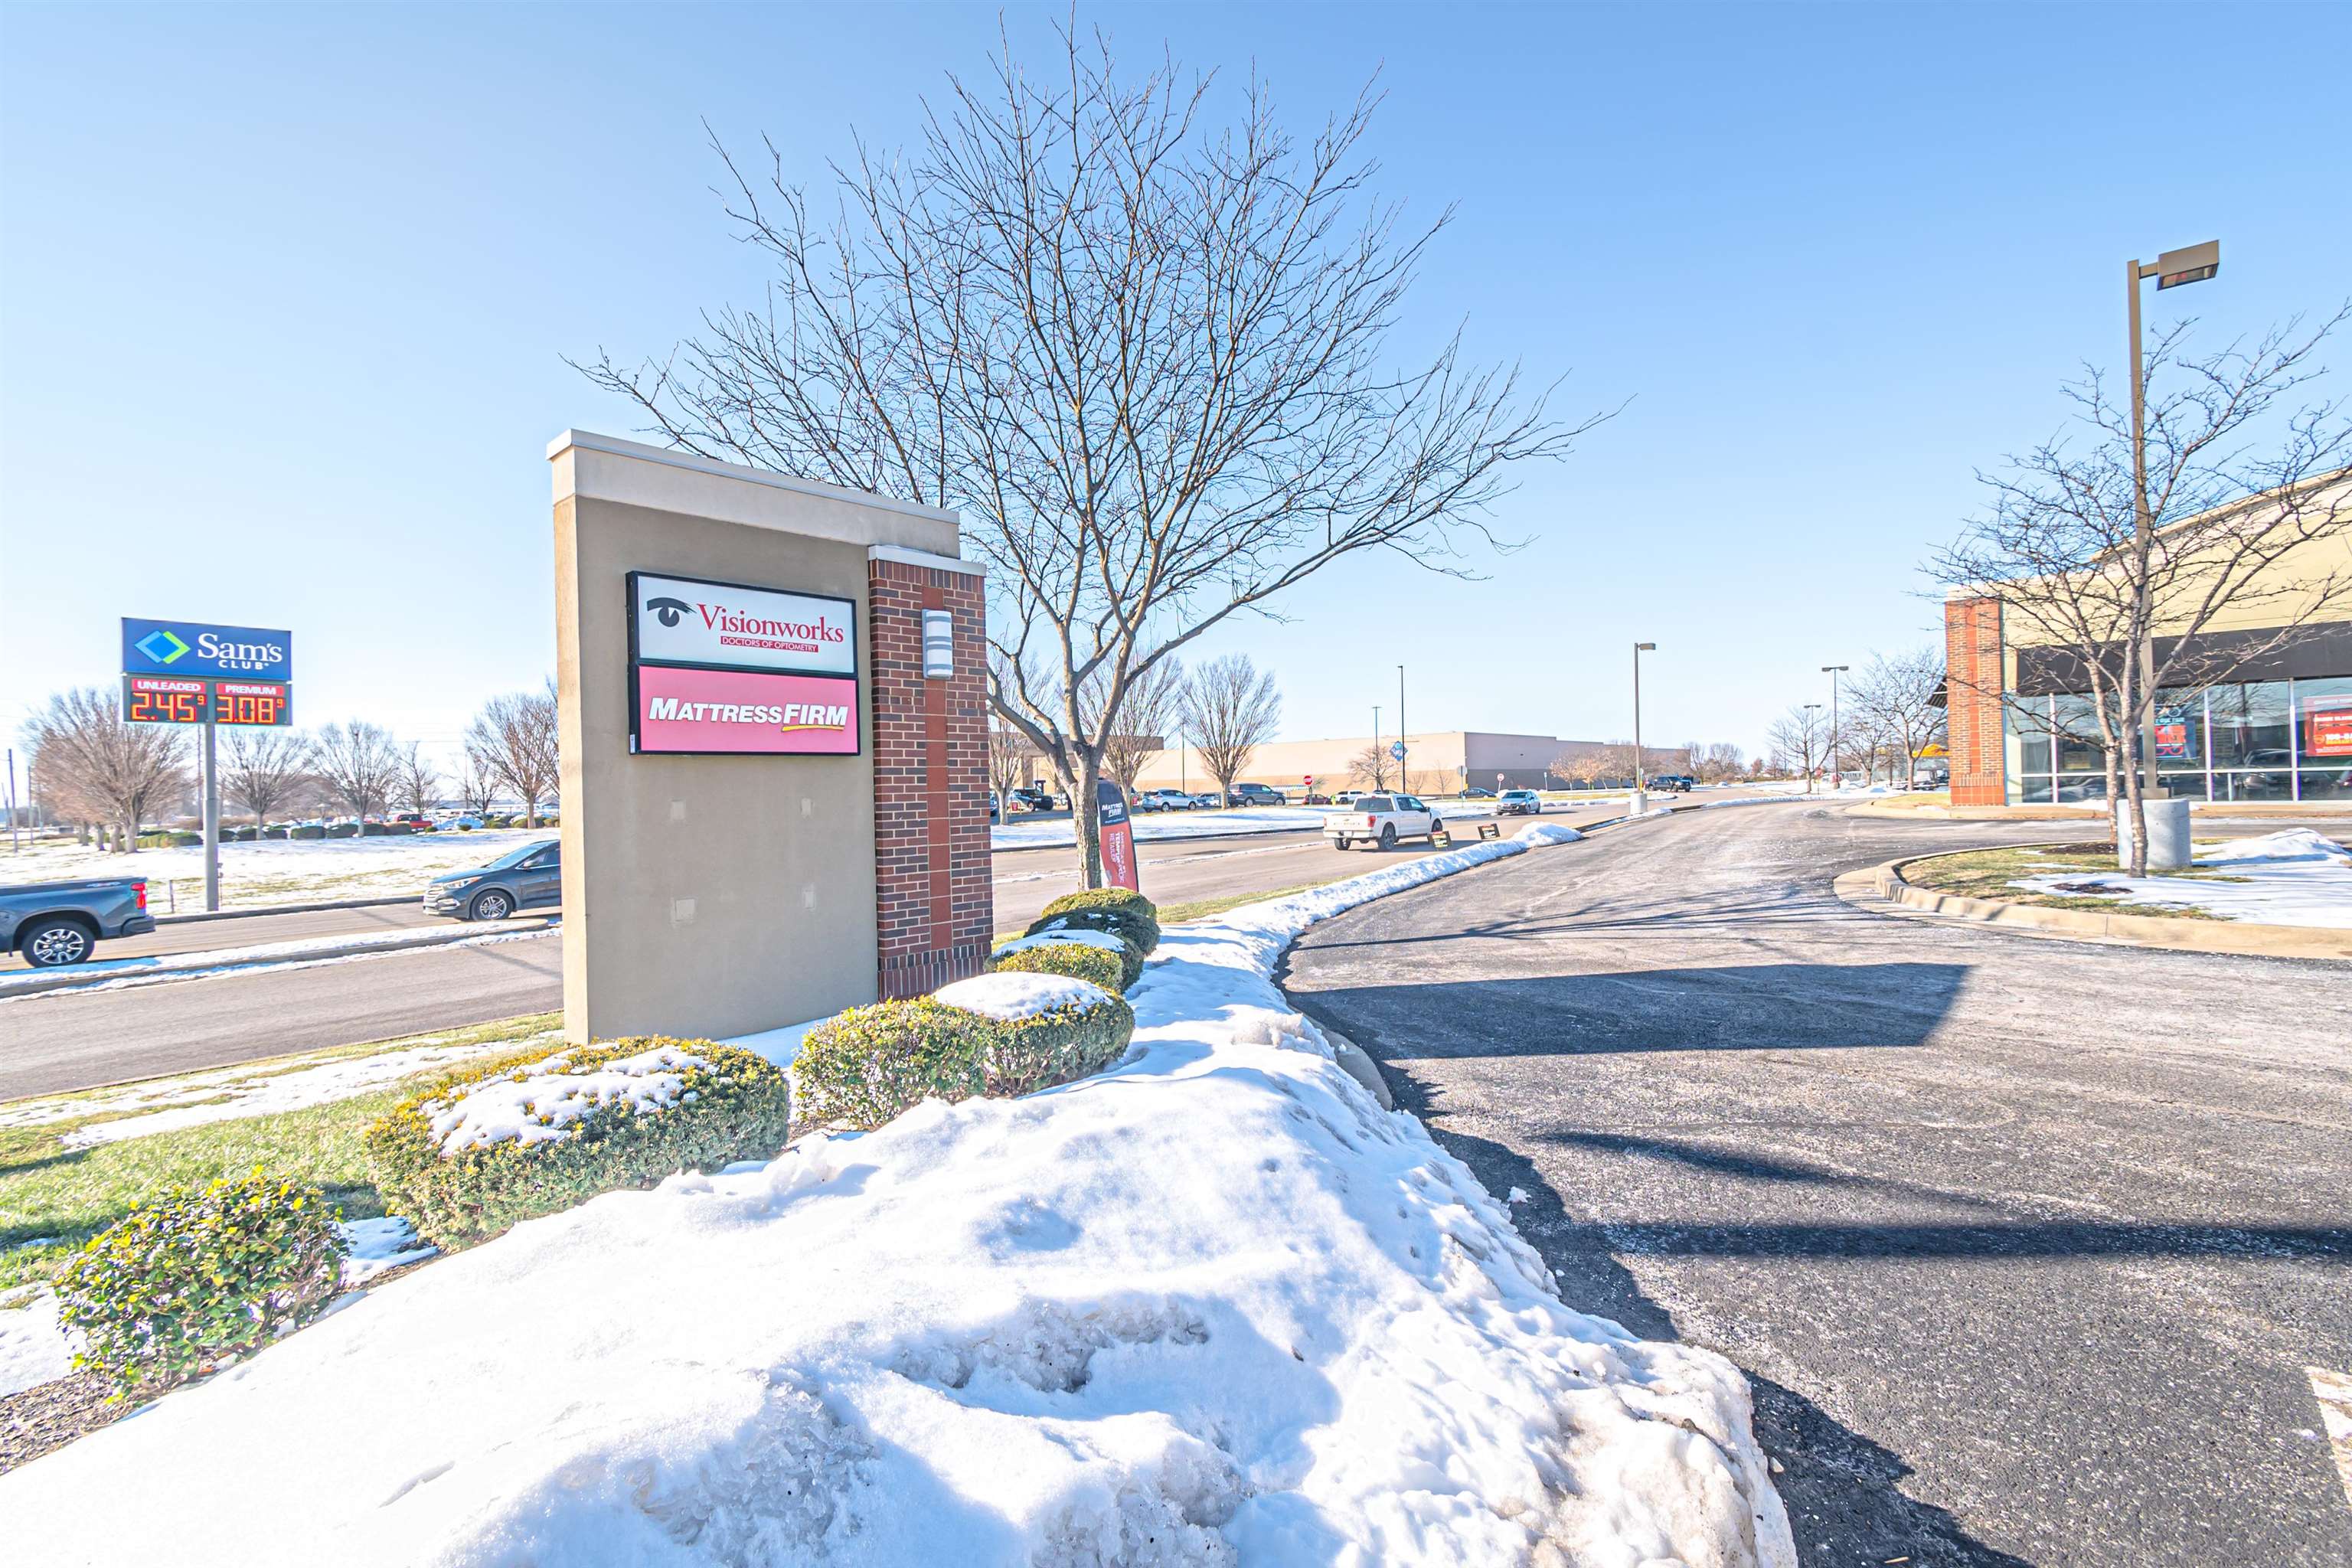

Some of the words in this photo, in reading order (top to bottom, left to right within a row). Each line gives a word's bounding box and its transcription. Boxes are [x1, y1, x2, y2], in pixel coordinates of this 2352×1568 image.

[696, 603, 844, 642] Visionworks
[198, 633, 283, 663] Sam's
[722, 637, 760, 648] DOCTORS
[761, 640, 773, 648] OF
[774, 642, 818, 652] OPTOMETRY
[218, 659, 264, 670] CLUB
[137, 680, 201, 691] UNLEADED
[225, 684, 277, 695] PREMIUM
